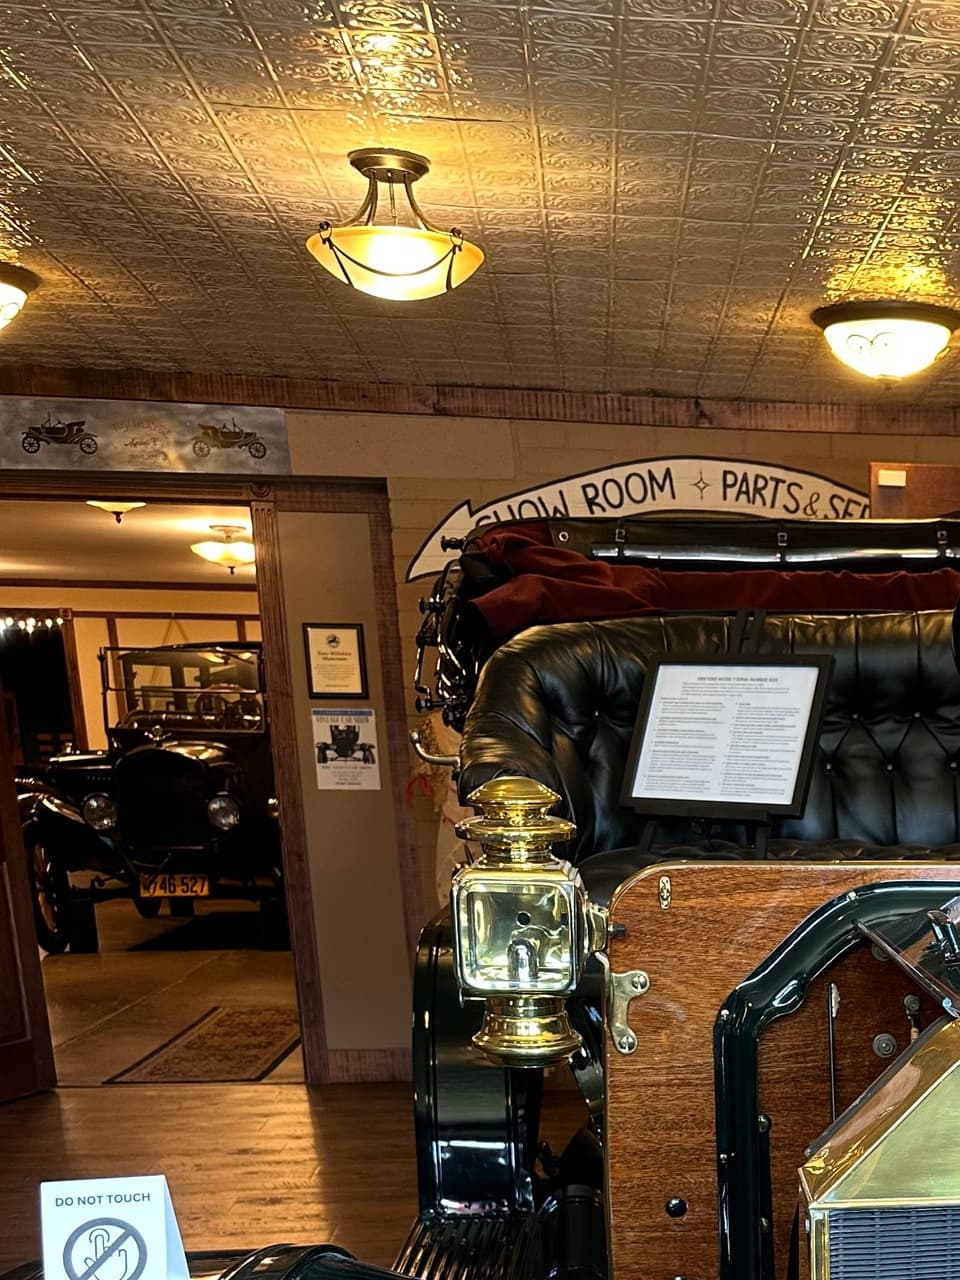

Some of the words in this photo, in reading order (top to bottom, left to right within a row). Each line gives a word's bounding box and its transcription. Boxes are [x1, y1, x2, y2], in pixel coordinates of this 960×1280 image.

[581, 466, 677, 515] ROOM
[722, 470, 803, 514] PARTS
[803, 491, 821, 517] &
[55, 1197, 74, 1207] DO
[77, 1195, 104, 1206] NOT
[106, 1192, 151, 1204] TOUCH
